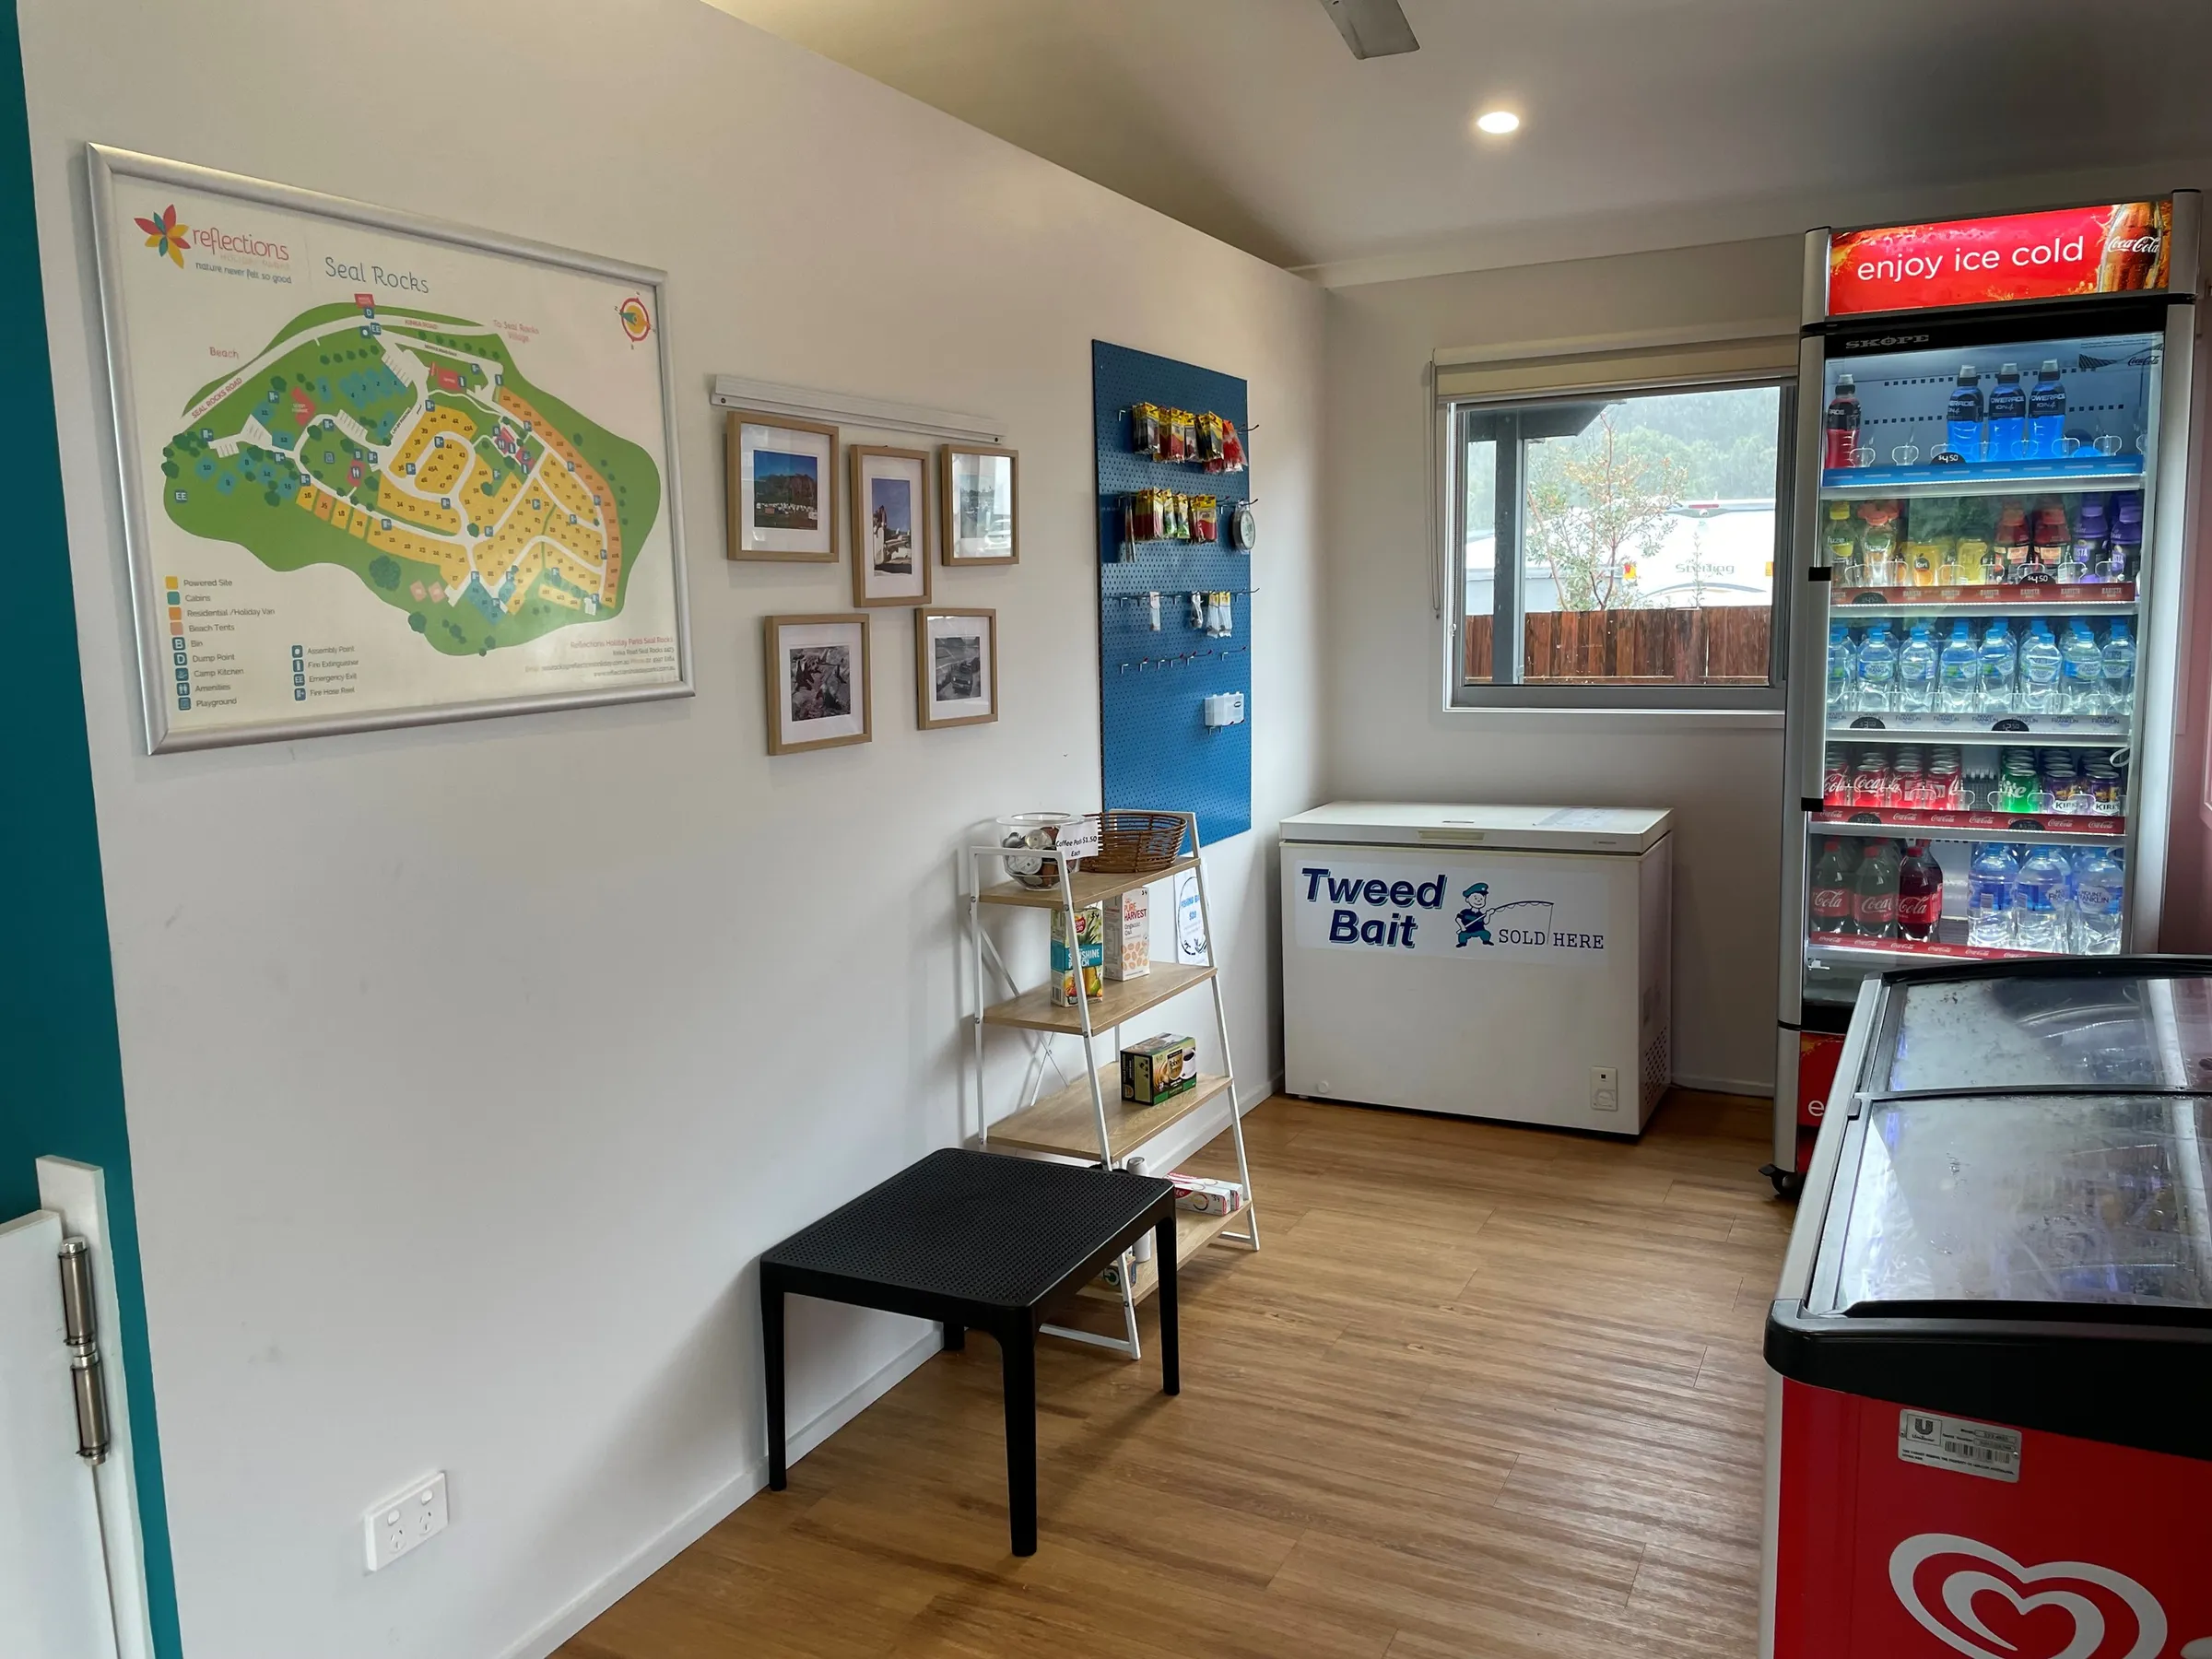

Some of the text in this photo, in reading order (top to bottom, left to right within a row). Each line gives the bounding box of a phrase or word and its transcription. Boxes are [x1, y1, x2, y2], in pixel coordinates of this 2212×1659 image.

[193, 227, 289, 260] reflections
[1857, 235, 2084, 285] enjoy ice cold
[195, 262, 222, 273] nature
[224, 267, 244, 276] never
[272, 275, 292, 284] good
[325, 256, 429, 294] Seal Rocks
[209, 347, 239, 359] Beach
[191, 377, 242, 418] SEAL ROCKS ROAD
[2030, 393, 2065, 401] OWERADE
[175, 491, 187, 500] EE
[183, 579, 233, 587] Powered Site
[187, 608, 229, 618] Residential
[189, 624, 213, 632] Beach
[175, 640, 182, 649] B
[307, 647, 337, 655] Assembly
[177, 654, 184, 664] D
[192, 653, 235, 664] Dump Point
[322, 660, 359, 668] Extinguisher
[194, 667, 244, 678] Camp Kitchen
[309, 674, 344, 683] Emergency
[194, 683, 231, 692] Amenities
[196, 698, 237, 707] Playground
[1301, 867, 1447, 910] Tweed
[1124, 909, 1147, 921] HARVEST
[1329, 909, 1418, 948] Bait
[1499, 928, 1605, 950] SOLD HERE
[1068, 949, 1100, 962] SSHINE
[1068, 959, 1089, 970] PCH
